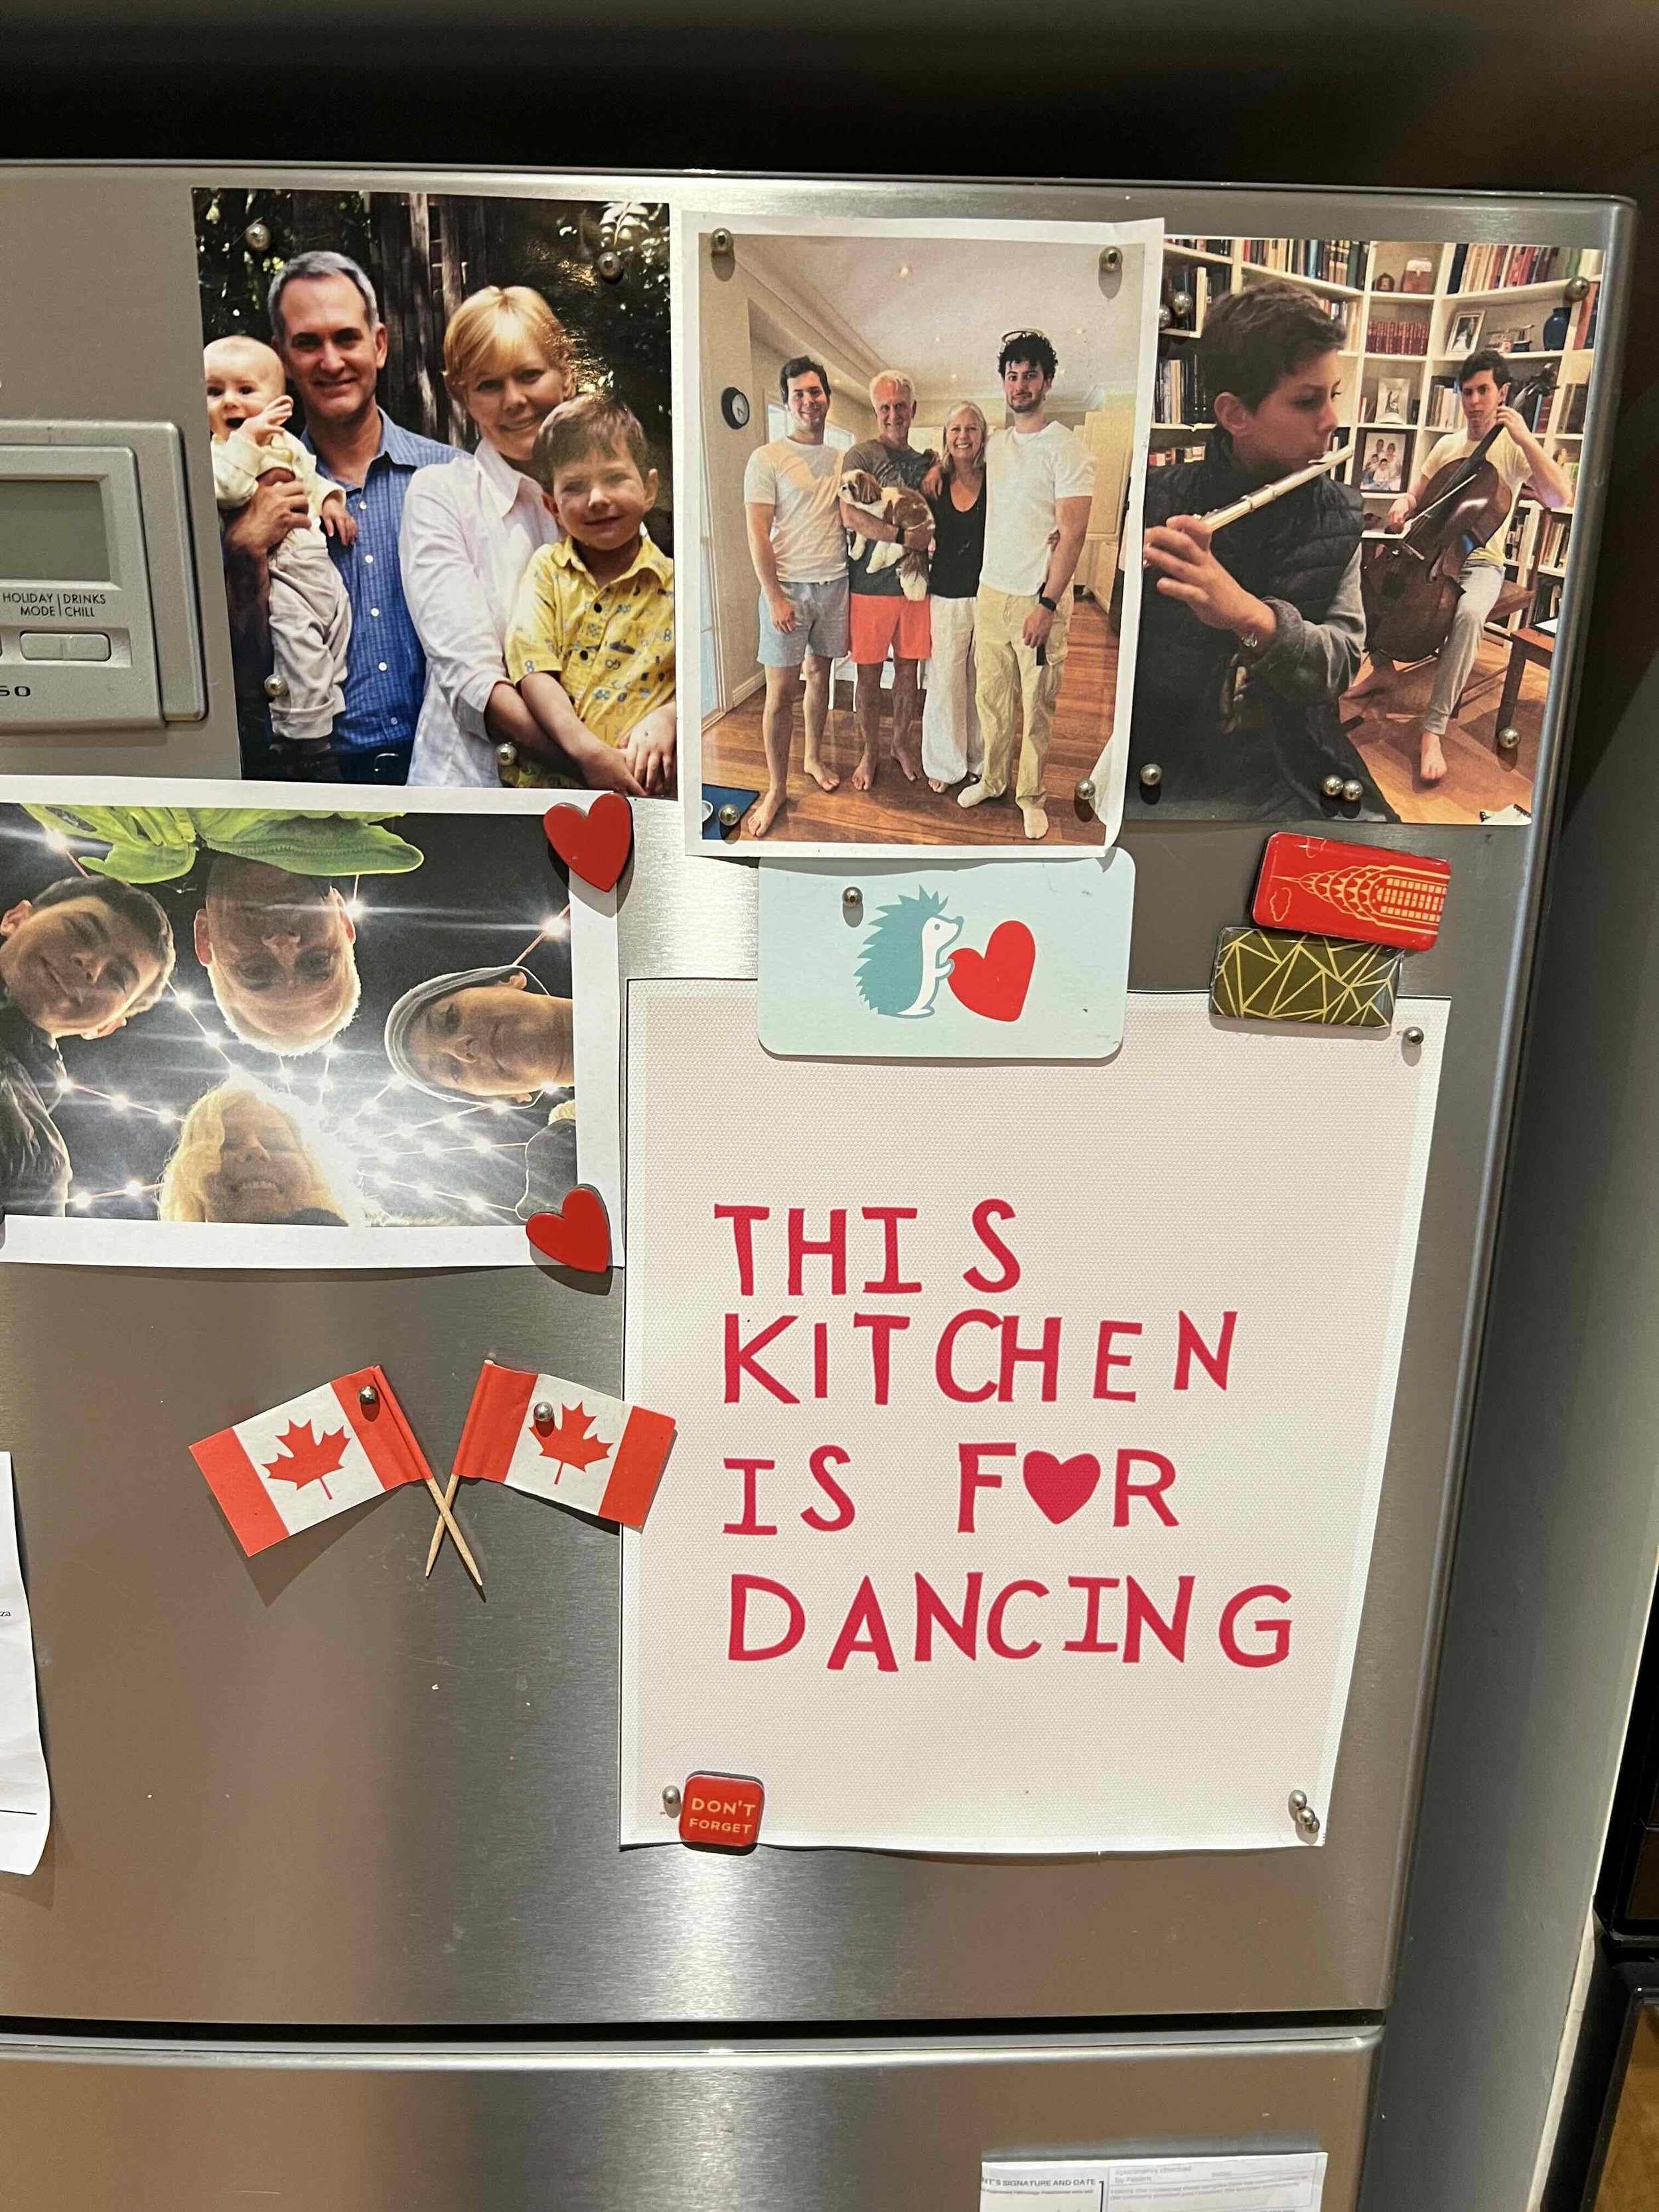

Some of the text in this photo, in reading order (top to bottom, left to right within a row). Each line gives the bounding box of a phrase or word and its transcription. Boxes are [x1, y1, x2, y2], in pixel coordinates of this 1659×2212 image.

[3, 592, 106, 605] HOLIDAY DRINKS
[21, 606, 96, 617] MODE CHILL
[714, 1199, 1021, 1297] THIS
[724, 1308, 1237, 1406] KITCHEN
[723, 1444, 856, 1536] IS
[728, 1571, 1292, 1673] DANCING
[689, 1818, 753, 1834] FORGET
[691, 1797, 756, 1816] DON'T
